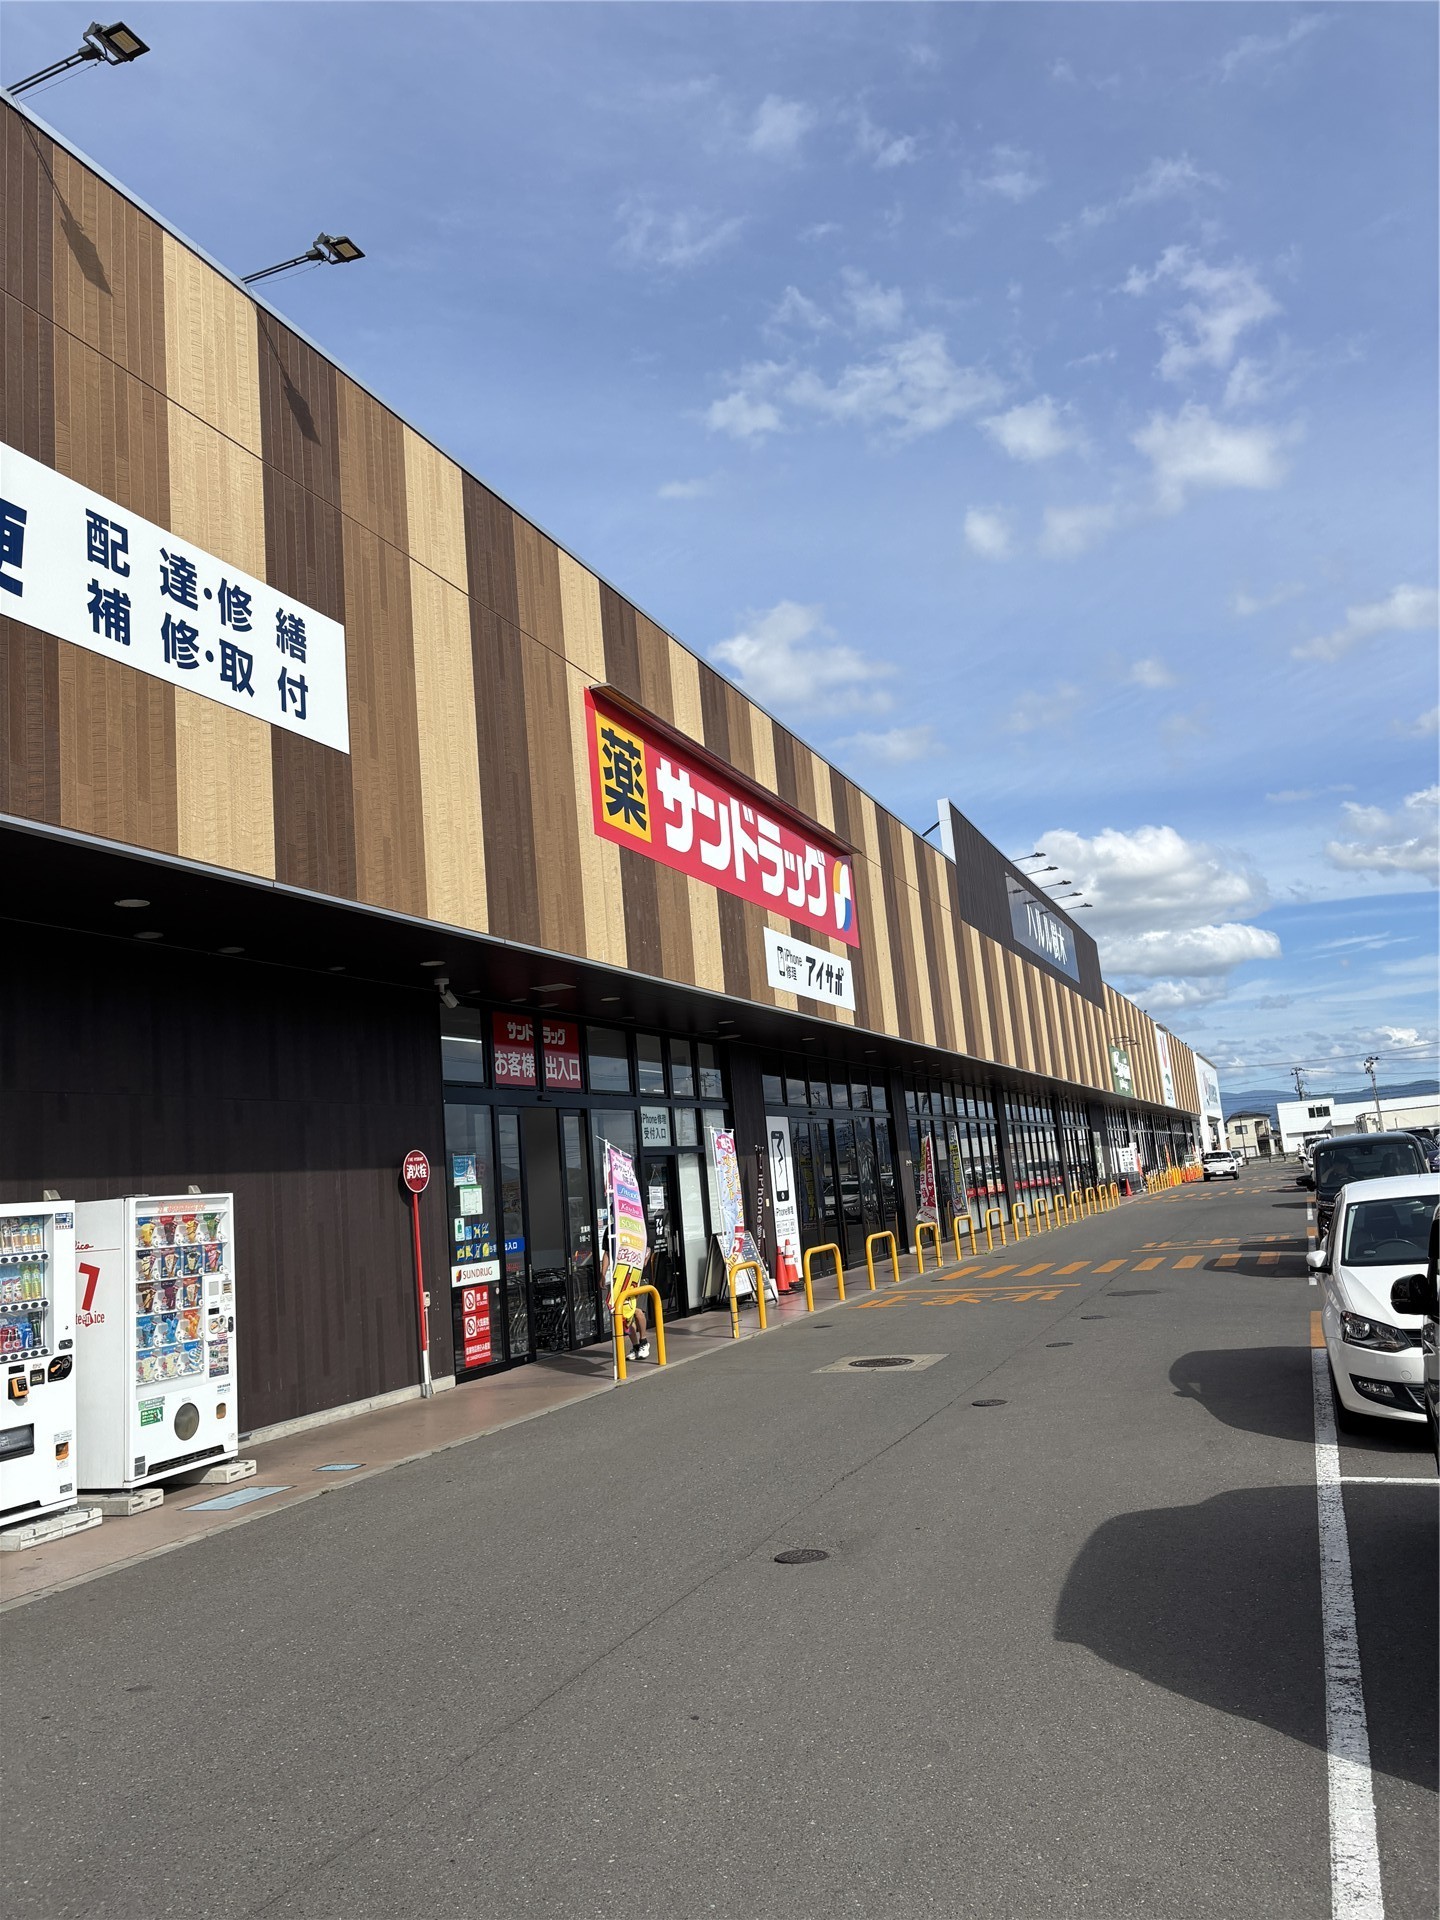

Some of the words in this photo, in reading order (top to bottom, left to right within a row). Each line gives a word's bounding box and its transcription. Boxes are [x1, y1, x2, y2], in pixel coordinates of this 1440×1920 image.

[601, 727, 647, 831] 薬
[655, 757, 827, 917] サンドラッグ
[806, 956, 845, 997] アイサポ
[643, 1127, 667, 1140] 受付入口
[406, 1163, 427, 1180] 消火栓
[462, 1266, 493, 1280] SUNDRUG
